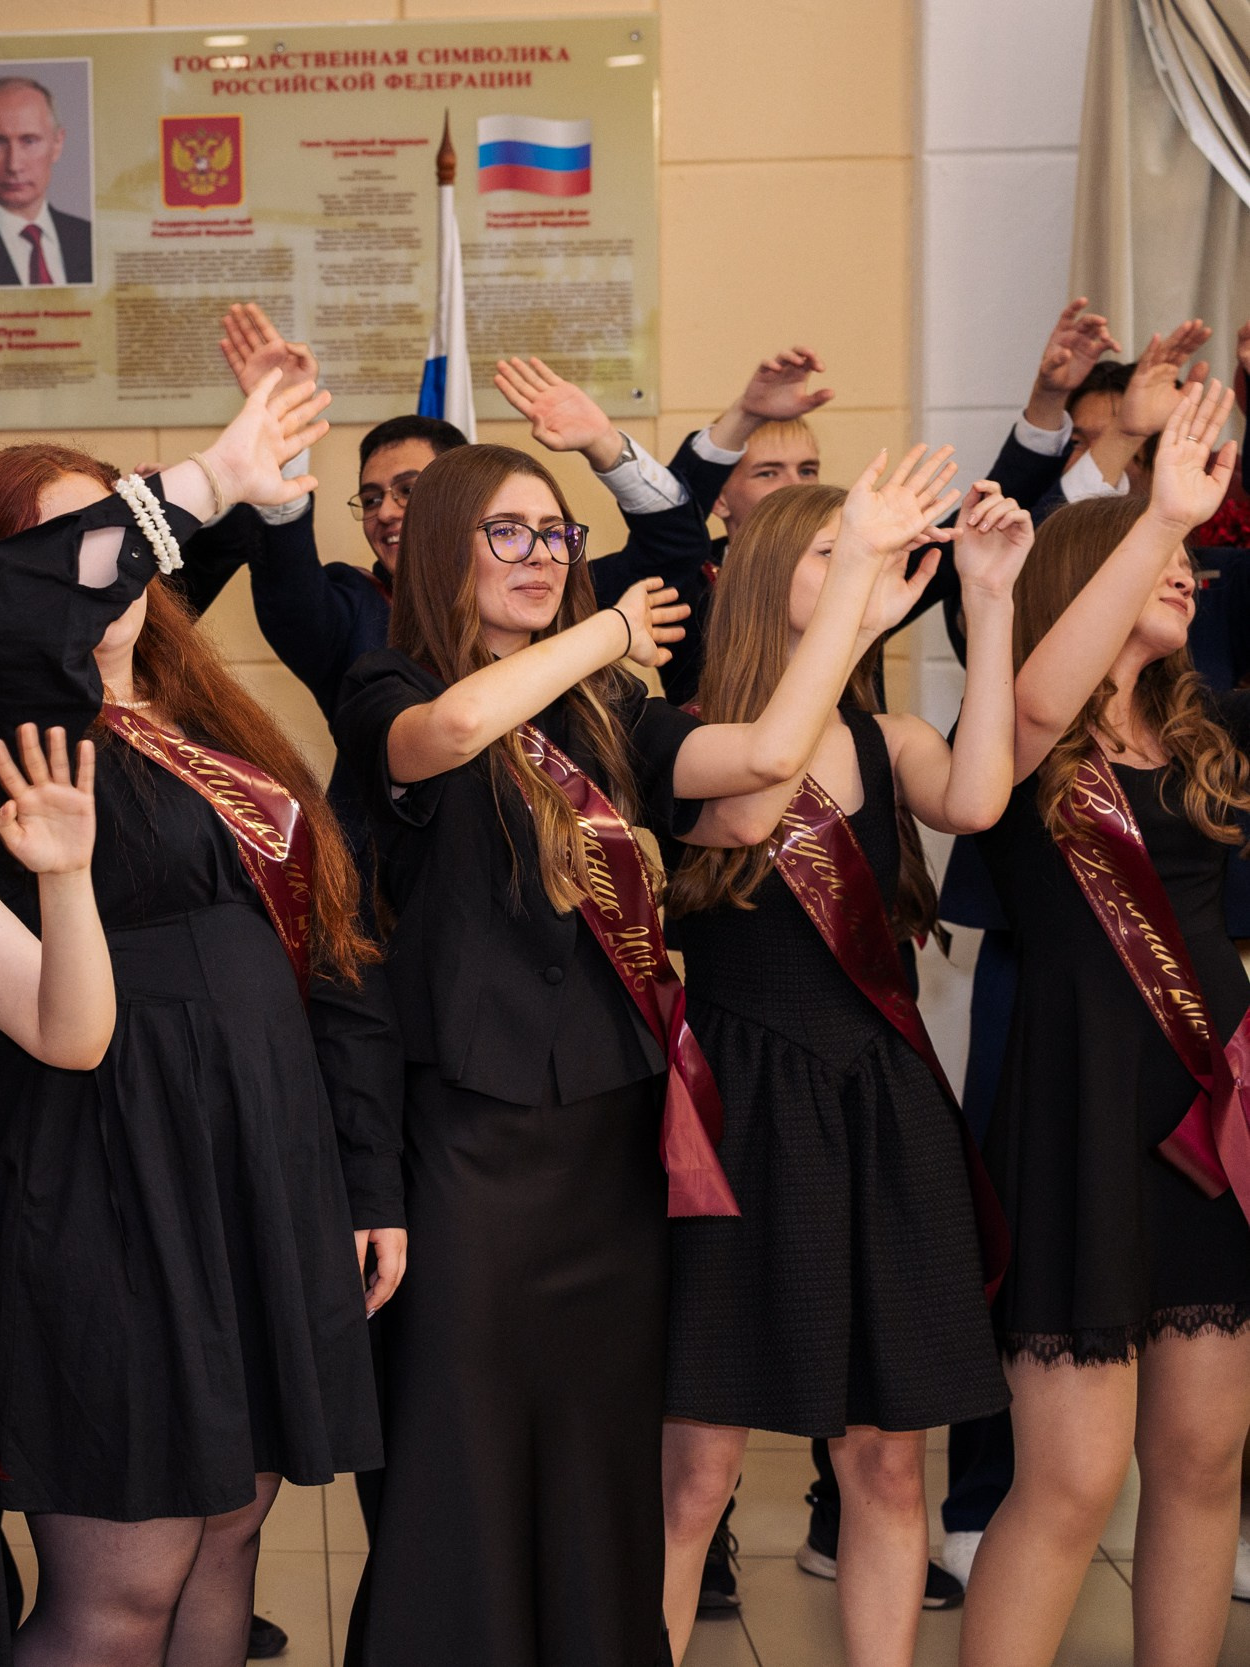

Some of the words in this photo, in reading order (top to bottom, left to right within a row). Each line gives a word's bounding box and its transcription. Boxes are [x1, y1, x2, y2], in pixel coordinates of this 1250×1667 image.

[173, 48, 409, 73] ГОСУДАРСТВЕННАЯ
[417, 44, 571, 66] СИМВОЛИКА
[211, 70, 376, 96] РОССИЙСКОЙ
[384, 70, 533, 90] ФЕДЕРАЦИИ
